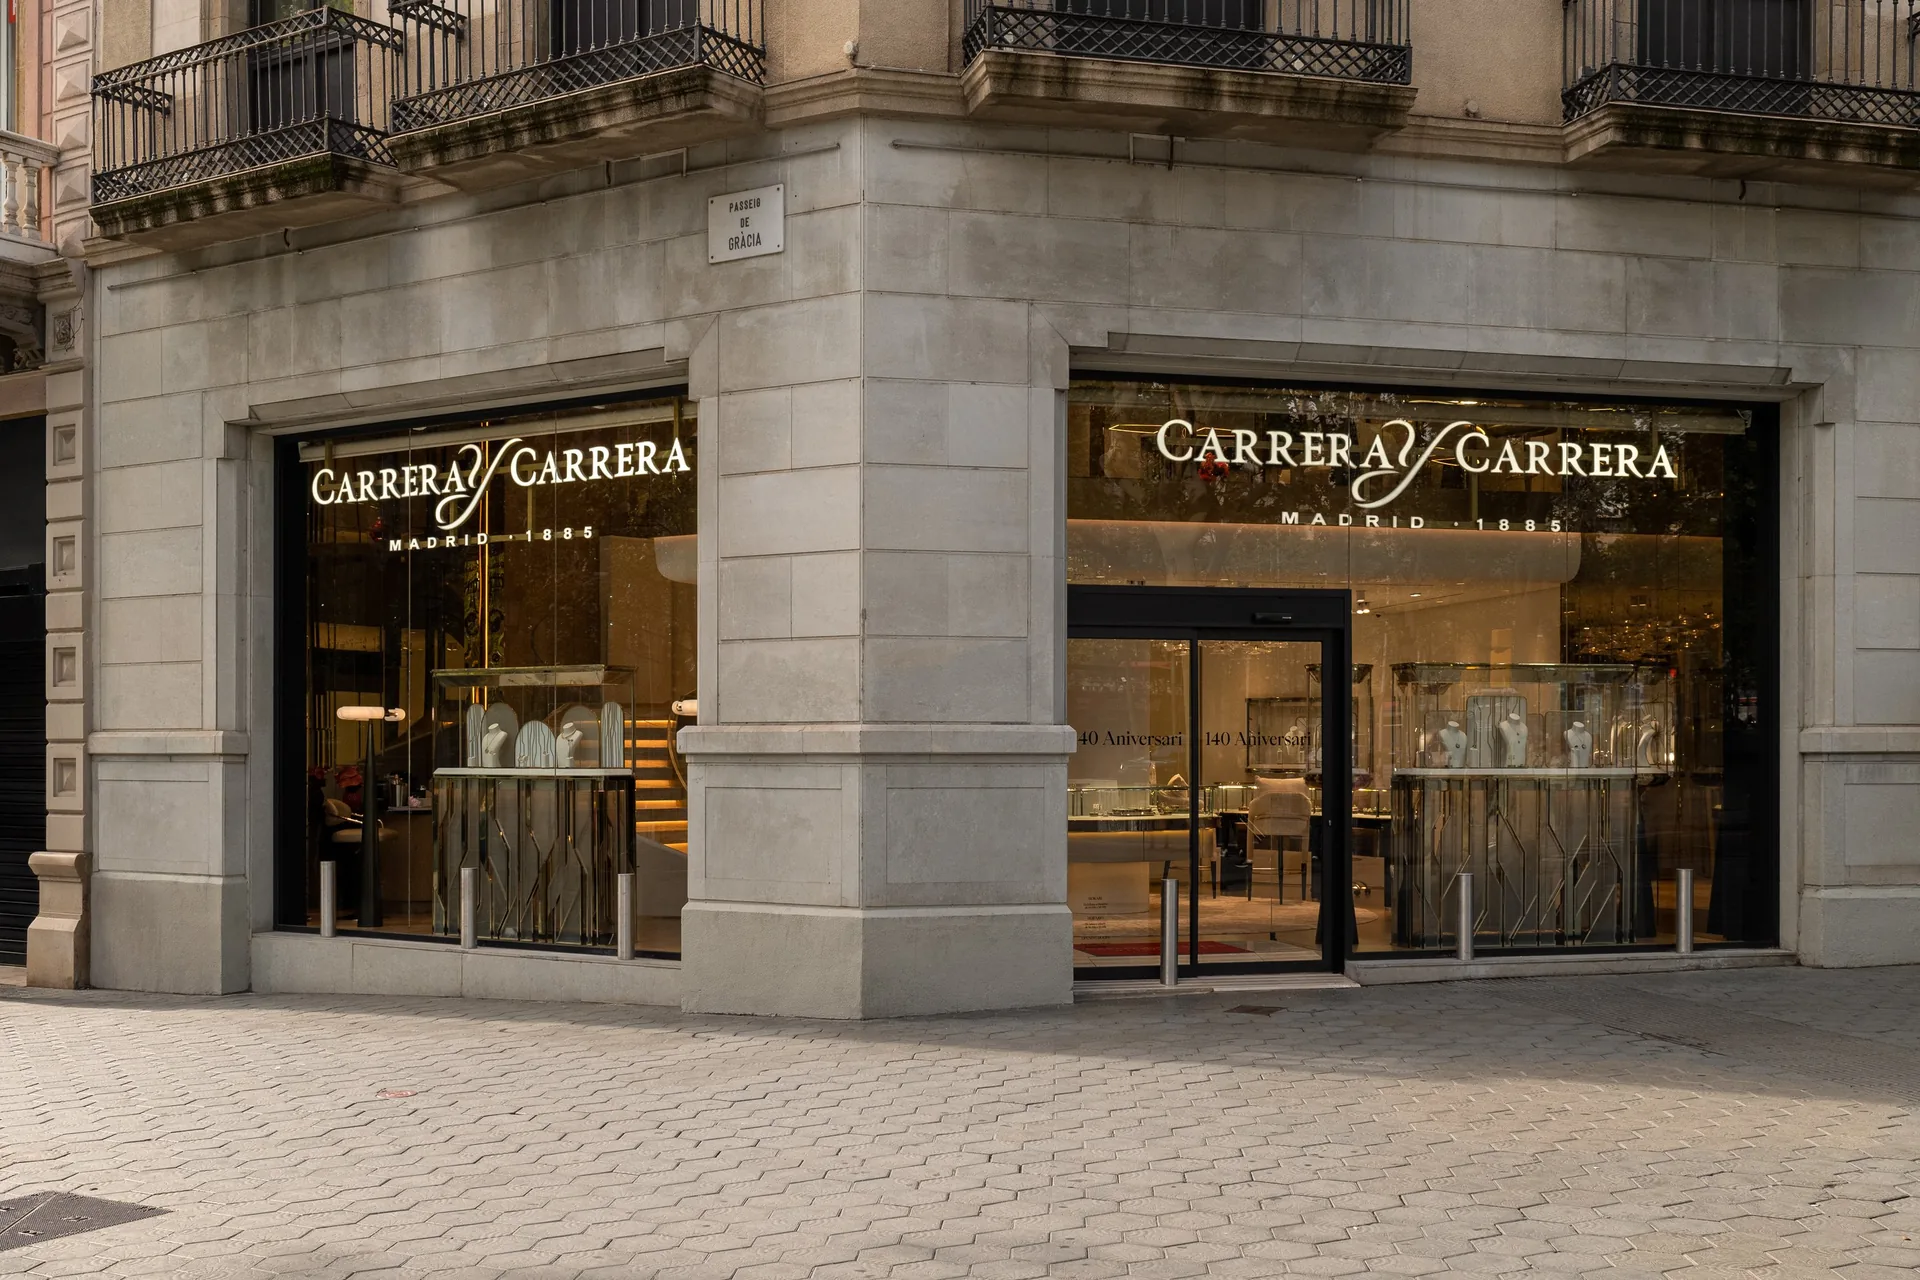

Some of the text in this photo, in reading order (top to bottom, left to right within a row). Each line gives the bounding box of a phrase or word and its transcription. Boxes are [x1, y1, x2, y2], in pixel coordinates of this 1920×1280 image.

[729, 198, 761, 213] PASSEIG
[740, 217, 750, 228] DE
[728, 231, 762, 251] GRÀCIA
[1157, 419, 1394, 469] CARRERA
[1456, 432, 1678, 479] CARRERA
[312, 460, 467, 505] CARRERA
[511, 437, 690, 487] CARRERA
[1281, 511, 1561, 532] MADRID 1885
[389, 526, 593, 551] MADRID 1885
[1078, 731, 1182, 746] 40 Aniversari
[1205, 731, 1312, 746] 140 Aniversari
